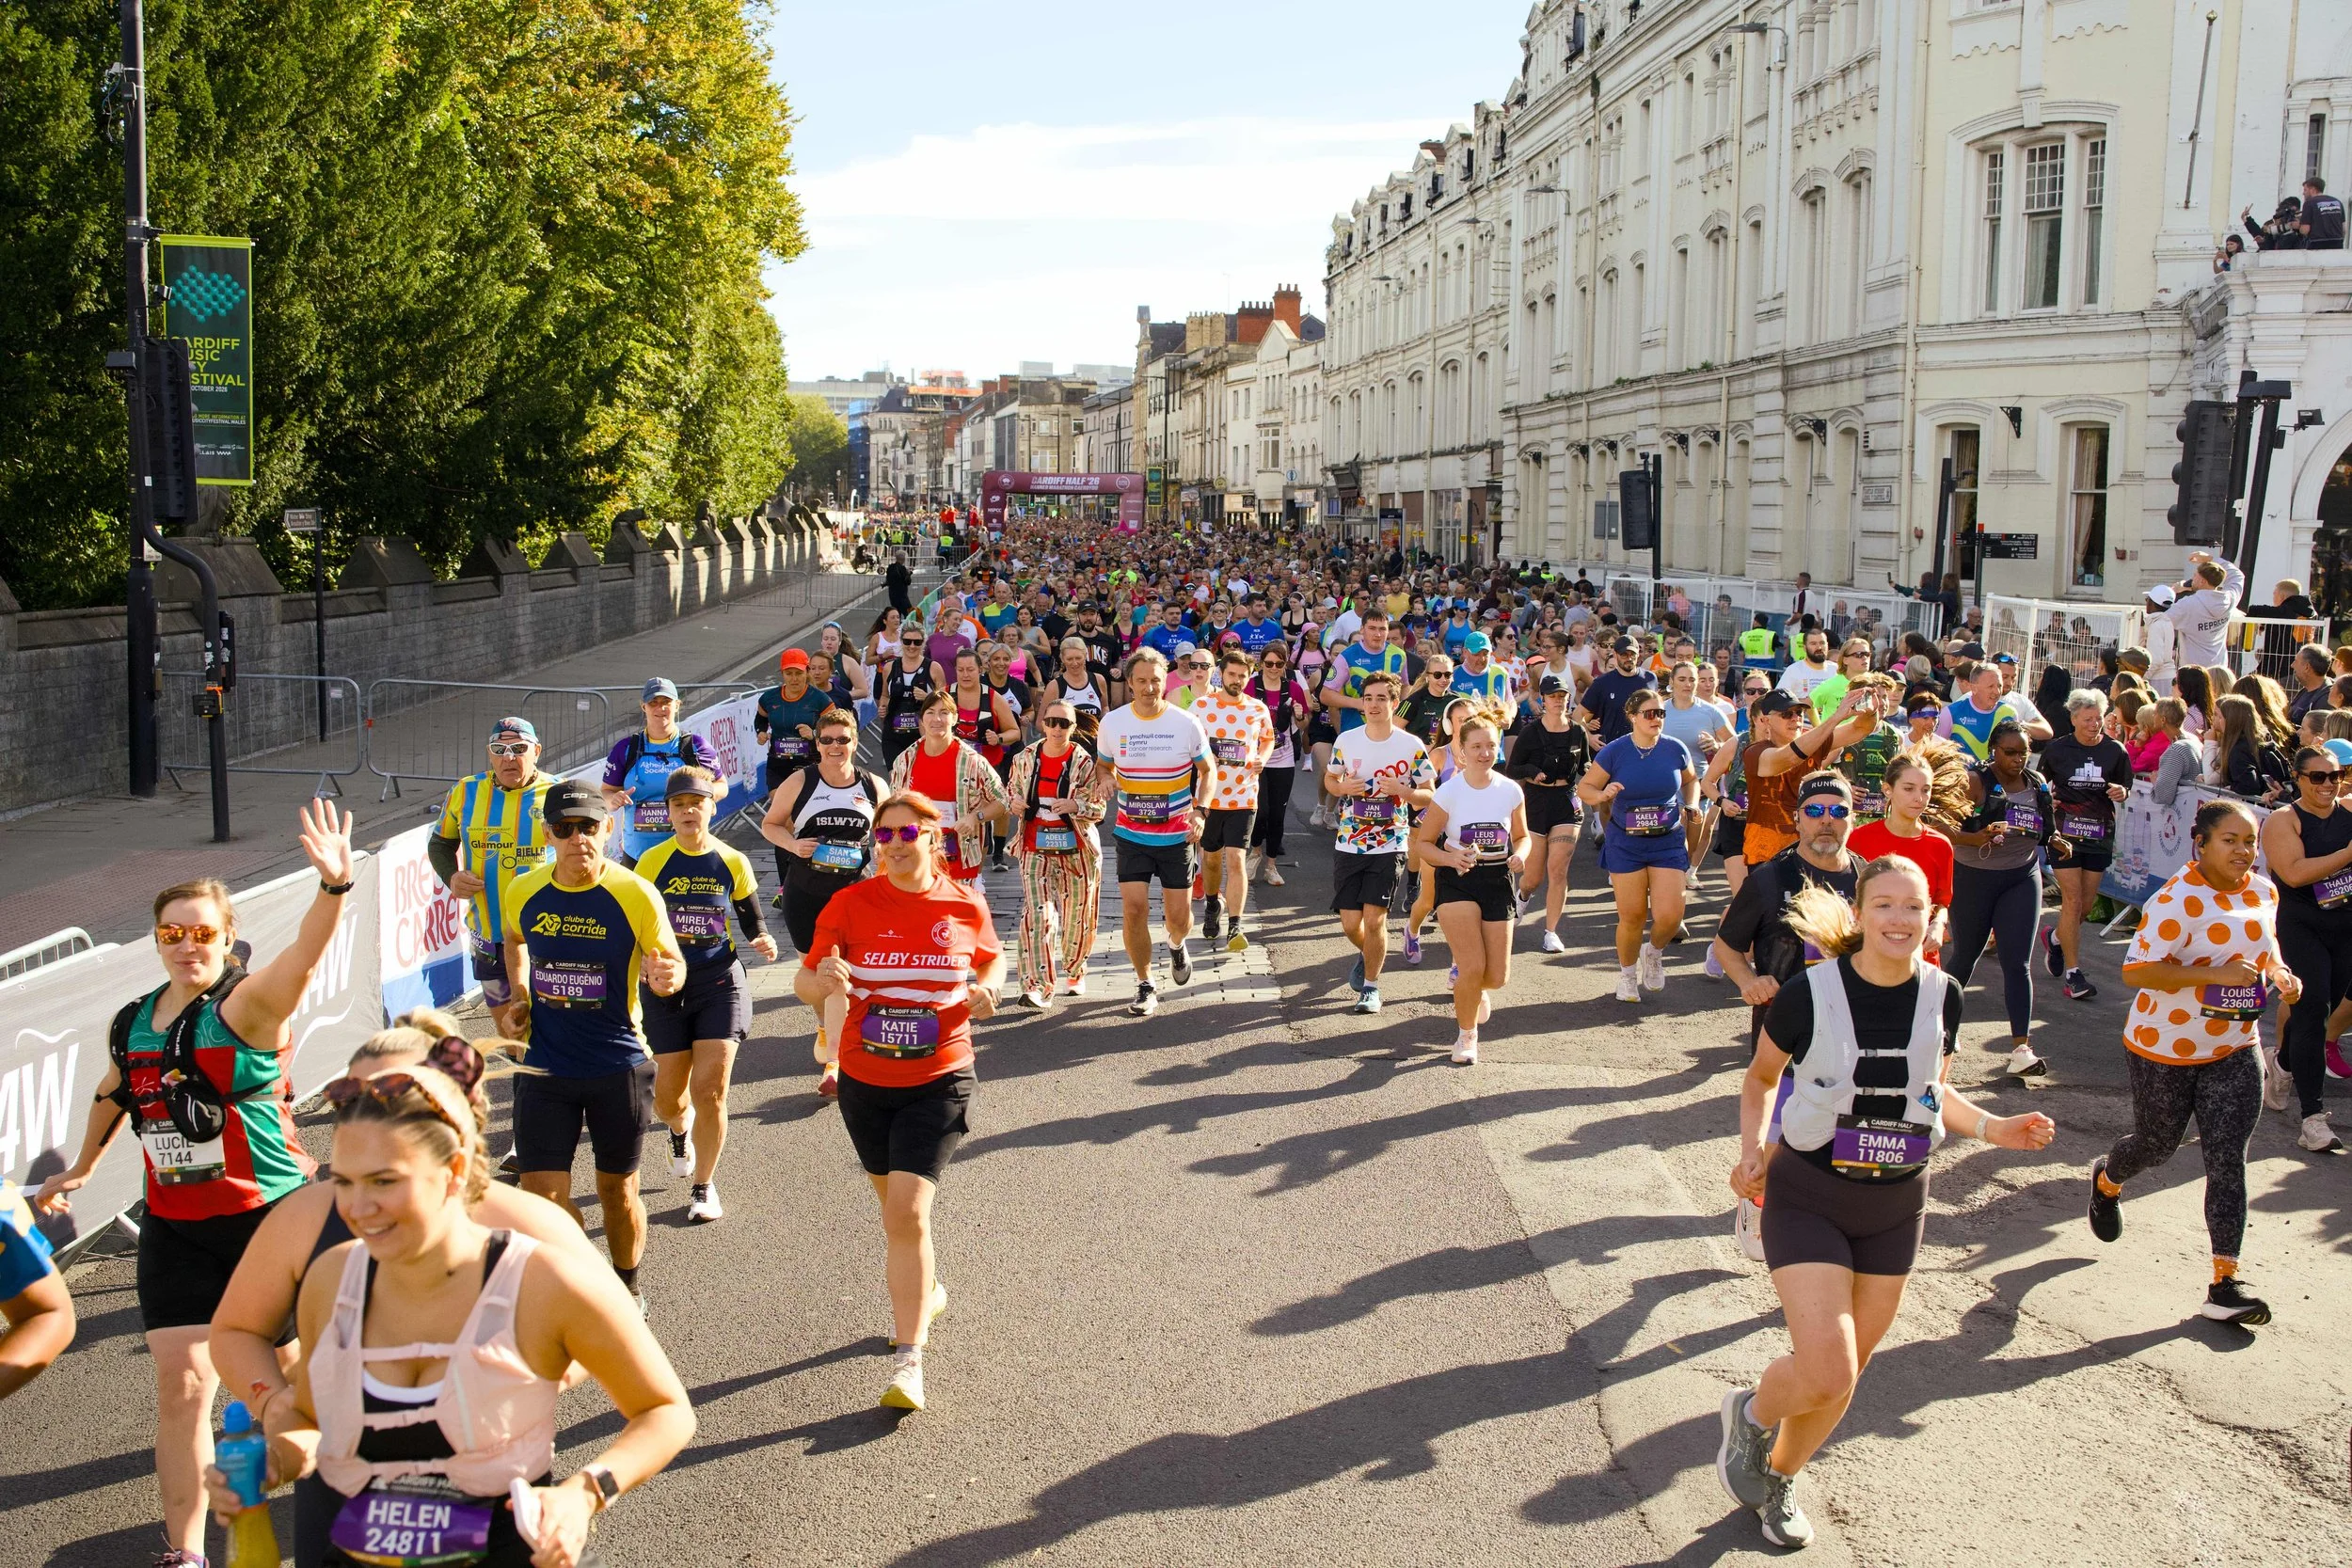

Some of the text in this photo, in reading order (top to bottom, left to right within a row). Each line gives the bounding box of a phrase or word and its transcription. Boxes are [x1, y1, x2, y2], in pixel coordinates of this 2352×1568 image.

[1065, 476, 1086, 485] HALF
[816, 816, 866, 828] ISLWYN
[2014, 812, 2035, 821] NJERI
[2068, 821, 2101, 832] SUSANNE
[2074, 829, 2092, 837] 1192
[470, 840, 515, 849] Glamour
[516, 847, 545, 857] BIELLA
[829, 847, 849, 856] SIAN
[826, 855, 850, 865] 10896
[691, 883, 724, 893] corrida
[564, 915, 585, 925] clube
[587, 916, 596, 925] de
[675, 914, 714, 926] MIRELA
[562, 924, 607, 936] corrida
[681, 925, 707, 935] 5496
[862, 952, 968, 968] SELBY STRIDERS
[535, 970, 603, 986] EDUARDO EUGÊNIO
[552, 985, 583, 997] 5189
[2220, 987, 2256, 998] LOUISE
[2221, 998, 2254, 1008] 23600
[882, 1020, 918, 1033] KATIE
[881, 1032, 918, 1045] 15711
[1870, 1118, 1899, 1128] CARDIFF
[1898, 1120, 1914, 1129] HALF
[1858, 1133, 1907, 1150] EMMA
[159, 1151, 193, 1165] 7144
[1857, 1148, 1904, 1164] 11806
[366, 1498, 452, 1529] HELEN
[364, 1527, 441, 1556] 24811
